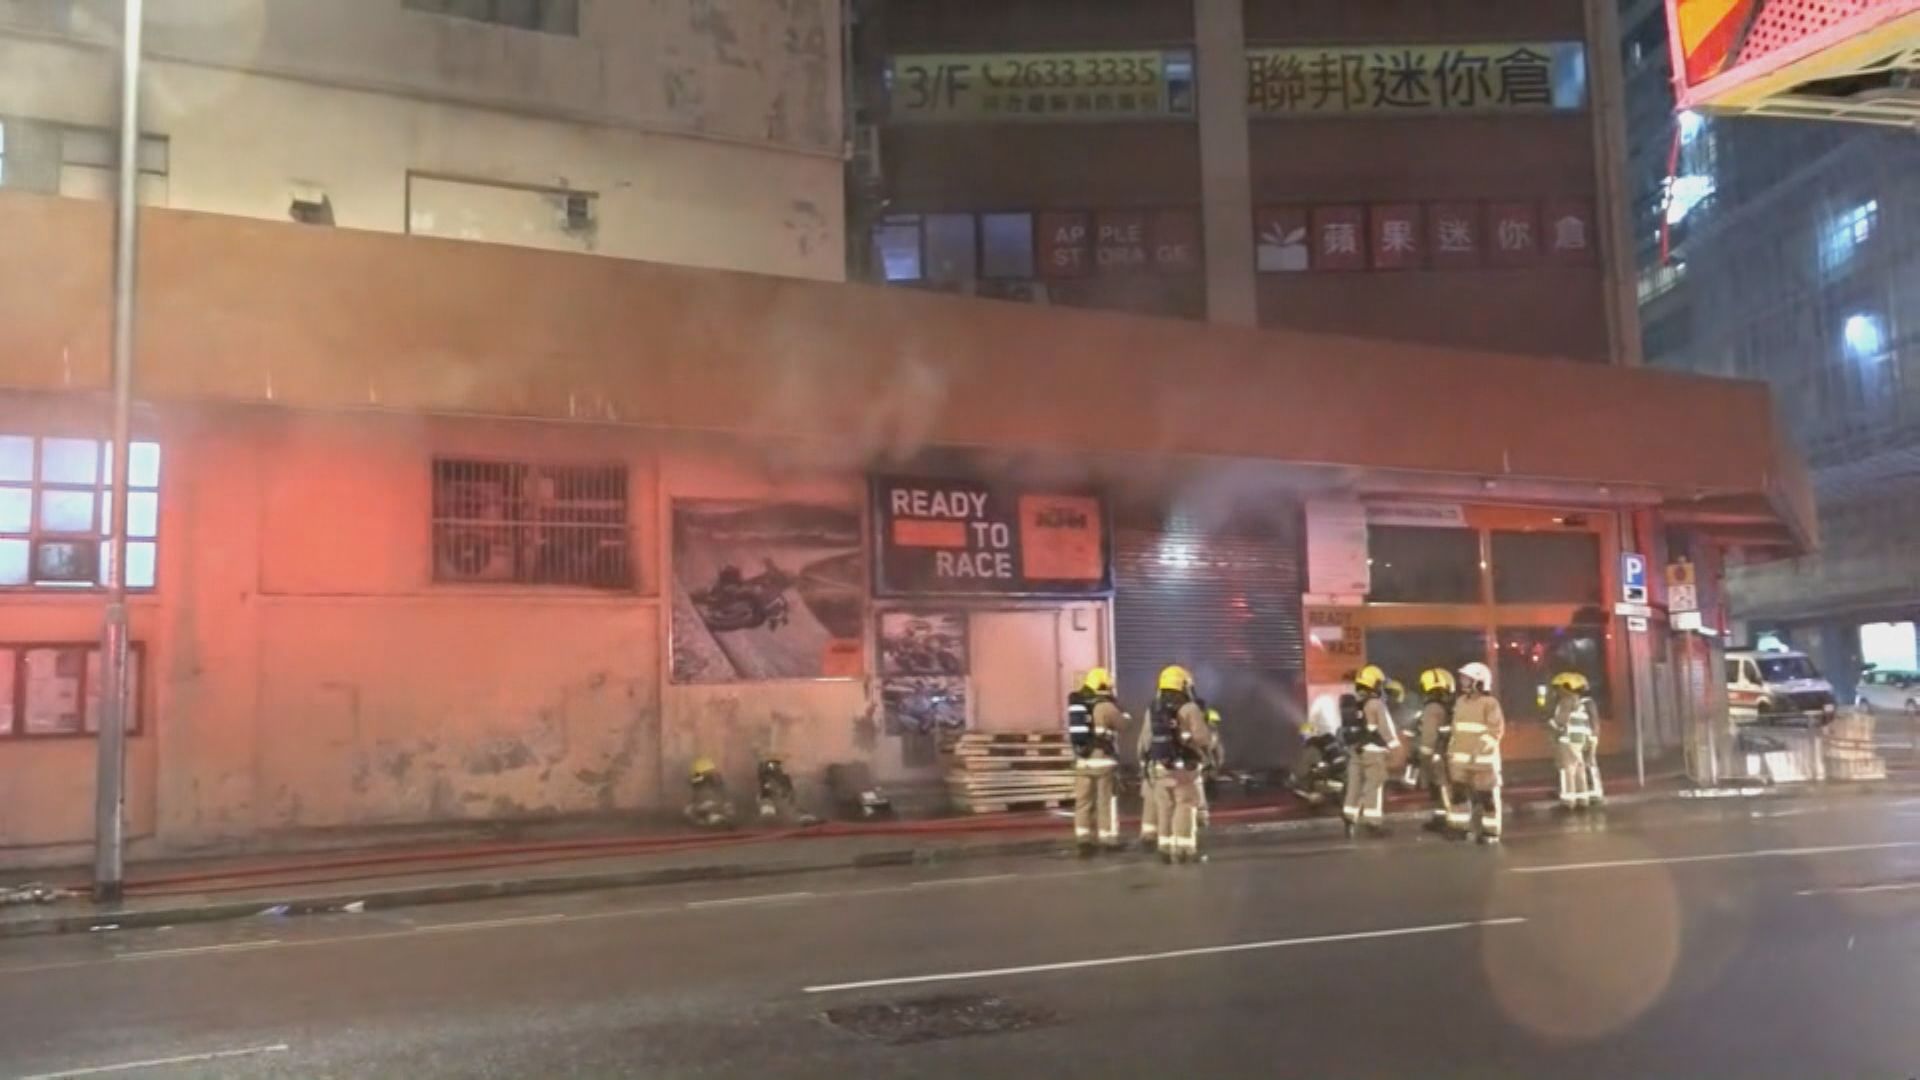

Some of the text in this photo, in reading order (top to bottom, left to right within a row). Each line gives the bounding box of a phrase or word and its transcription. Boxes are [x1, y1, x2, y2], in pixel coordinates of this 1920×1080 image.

[904, 65, 971, 109] 3/F
[1247, 48, 1552, 110] 聯邦迷你倉
[891, 489, 988, 518] READY
[971, 522, 1009, 548] TO
[936, 551, 1012, 578] RACE
[1627, 558, 1642, 583] P
